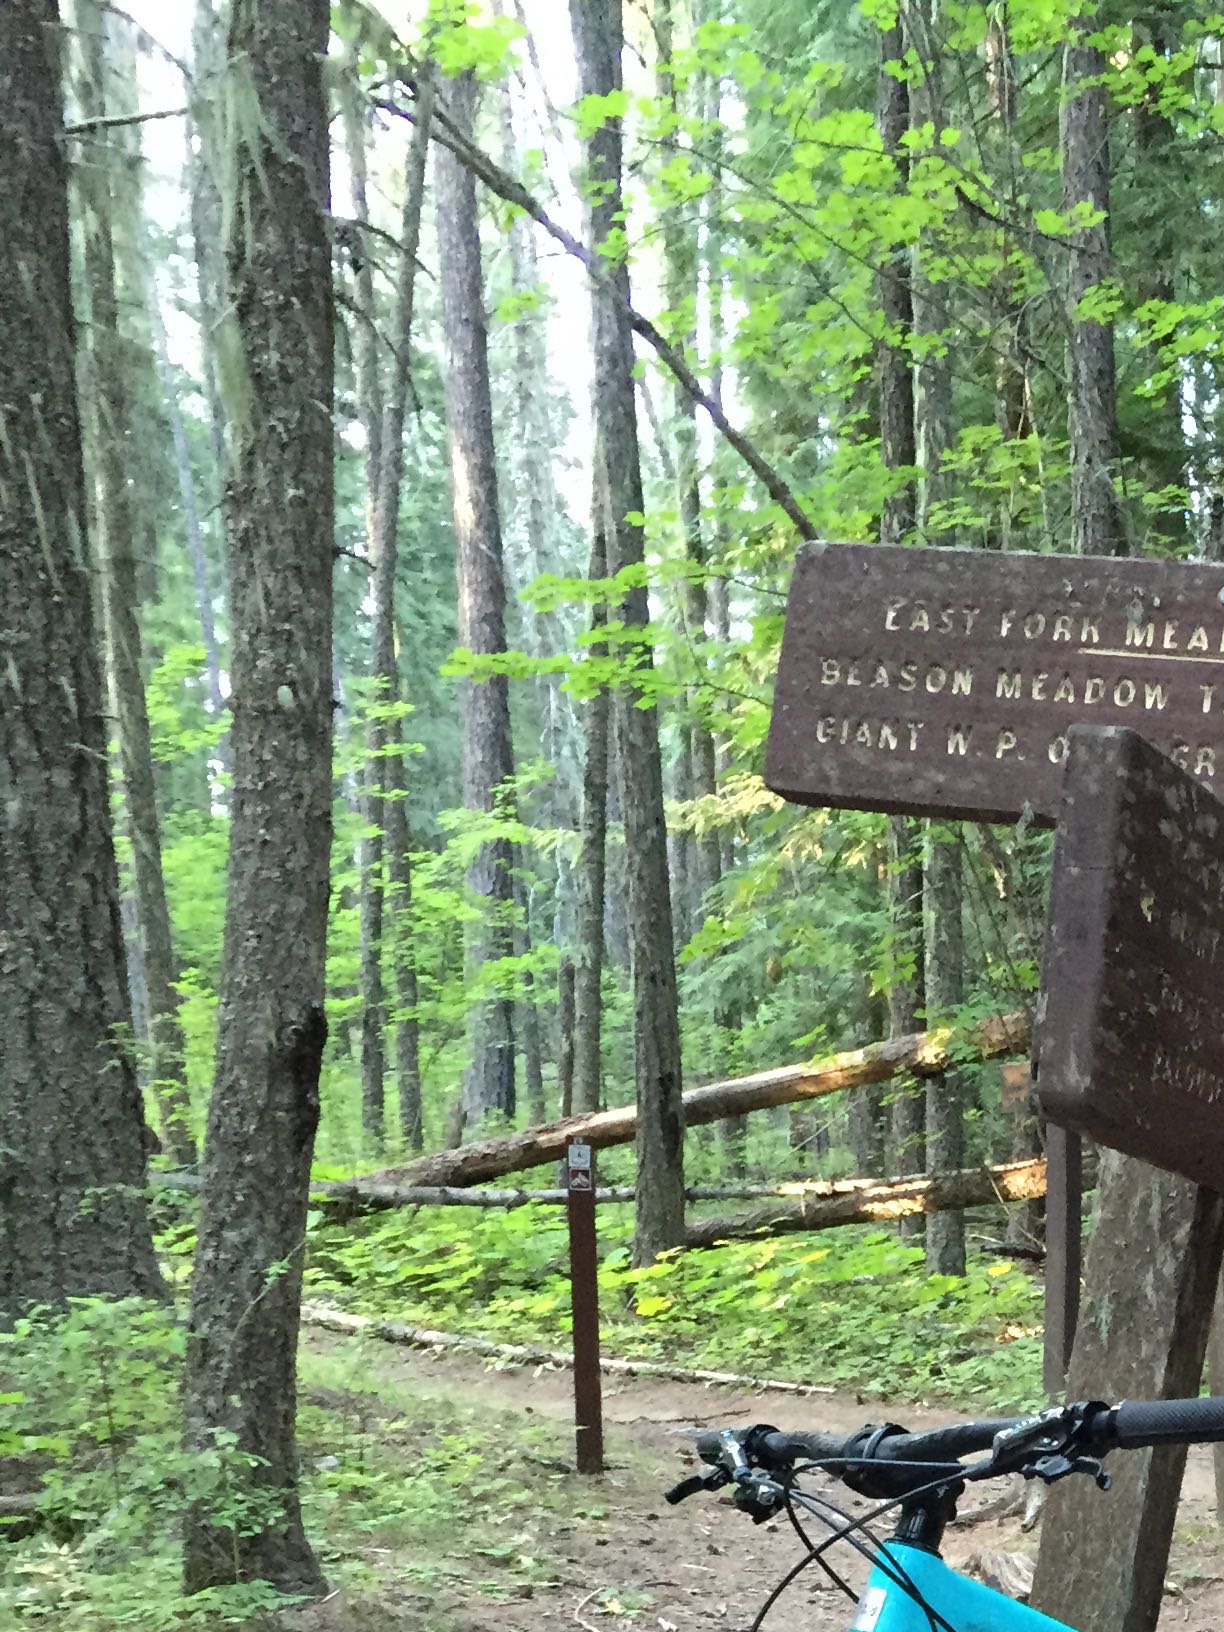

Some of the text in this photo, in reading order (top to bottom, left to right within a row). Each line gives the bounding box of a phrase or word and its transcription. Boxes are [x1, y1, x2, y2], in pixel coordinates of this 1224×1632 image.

[885, 603, 981, 636] EAST
[999, 608, 1100, 643] FORK
[820, 656, 974, 696] BEASON
[995, 669, 1169, 711] MEADOW
[816, 716, 925, 751] GIANT
